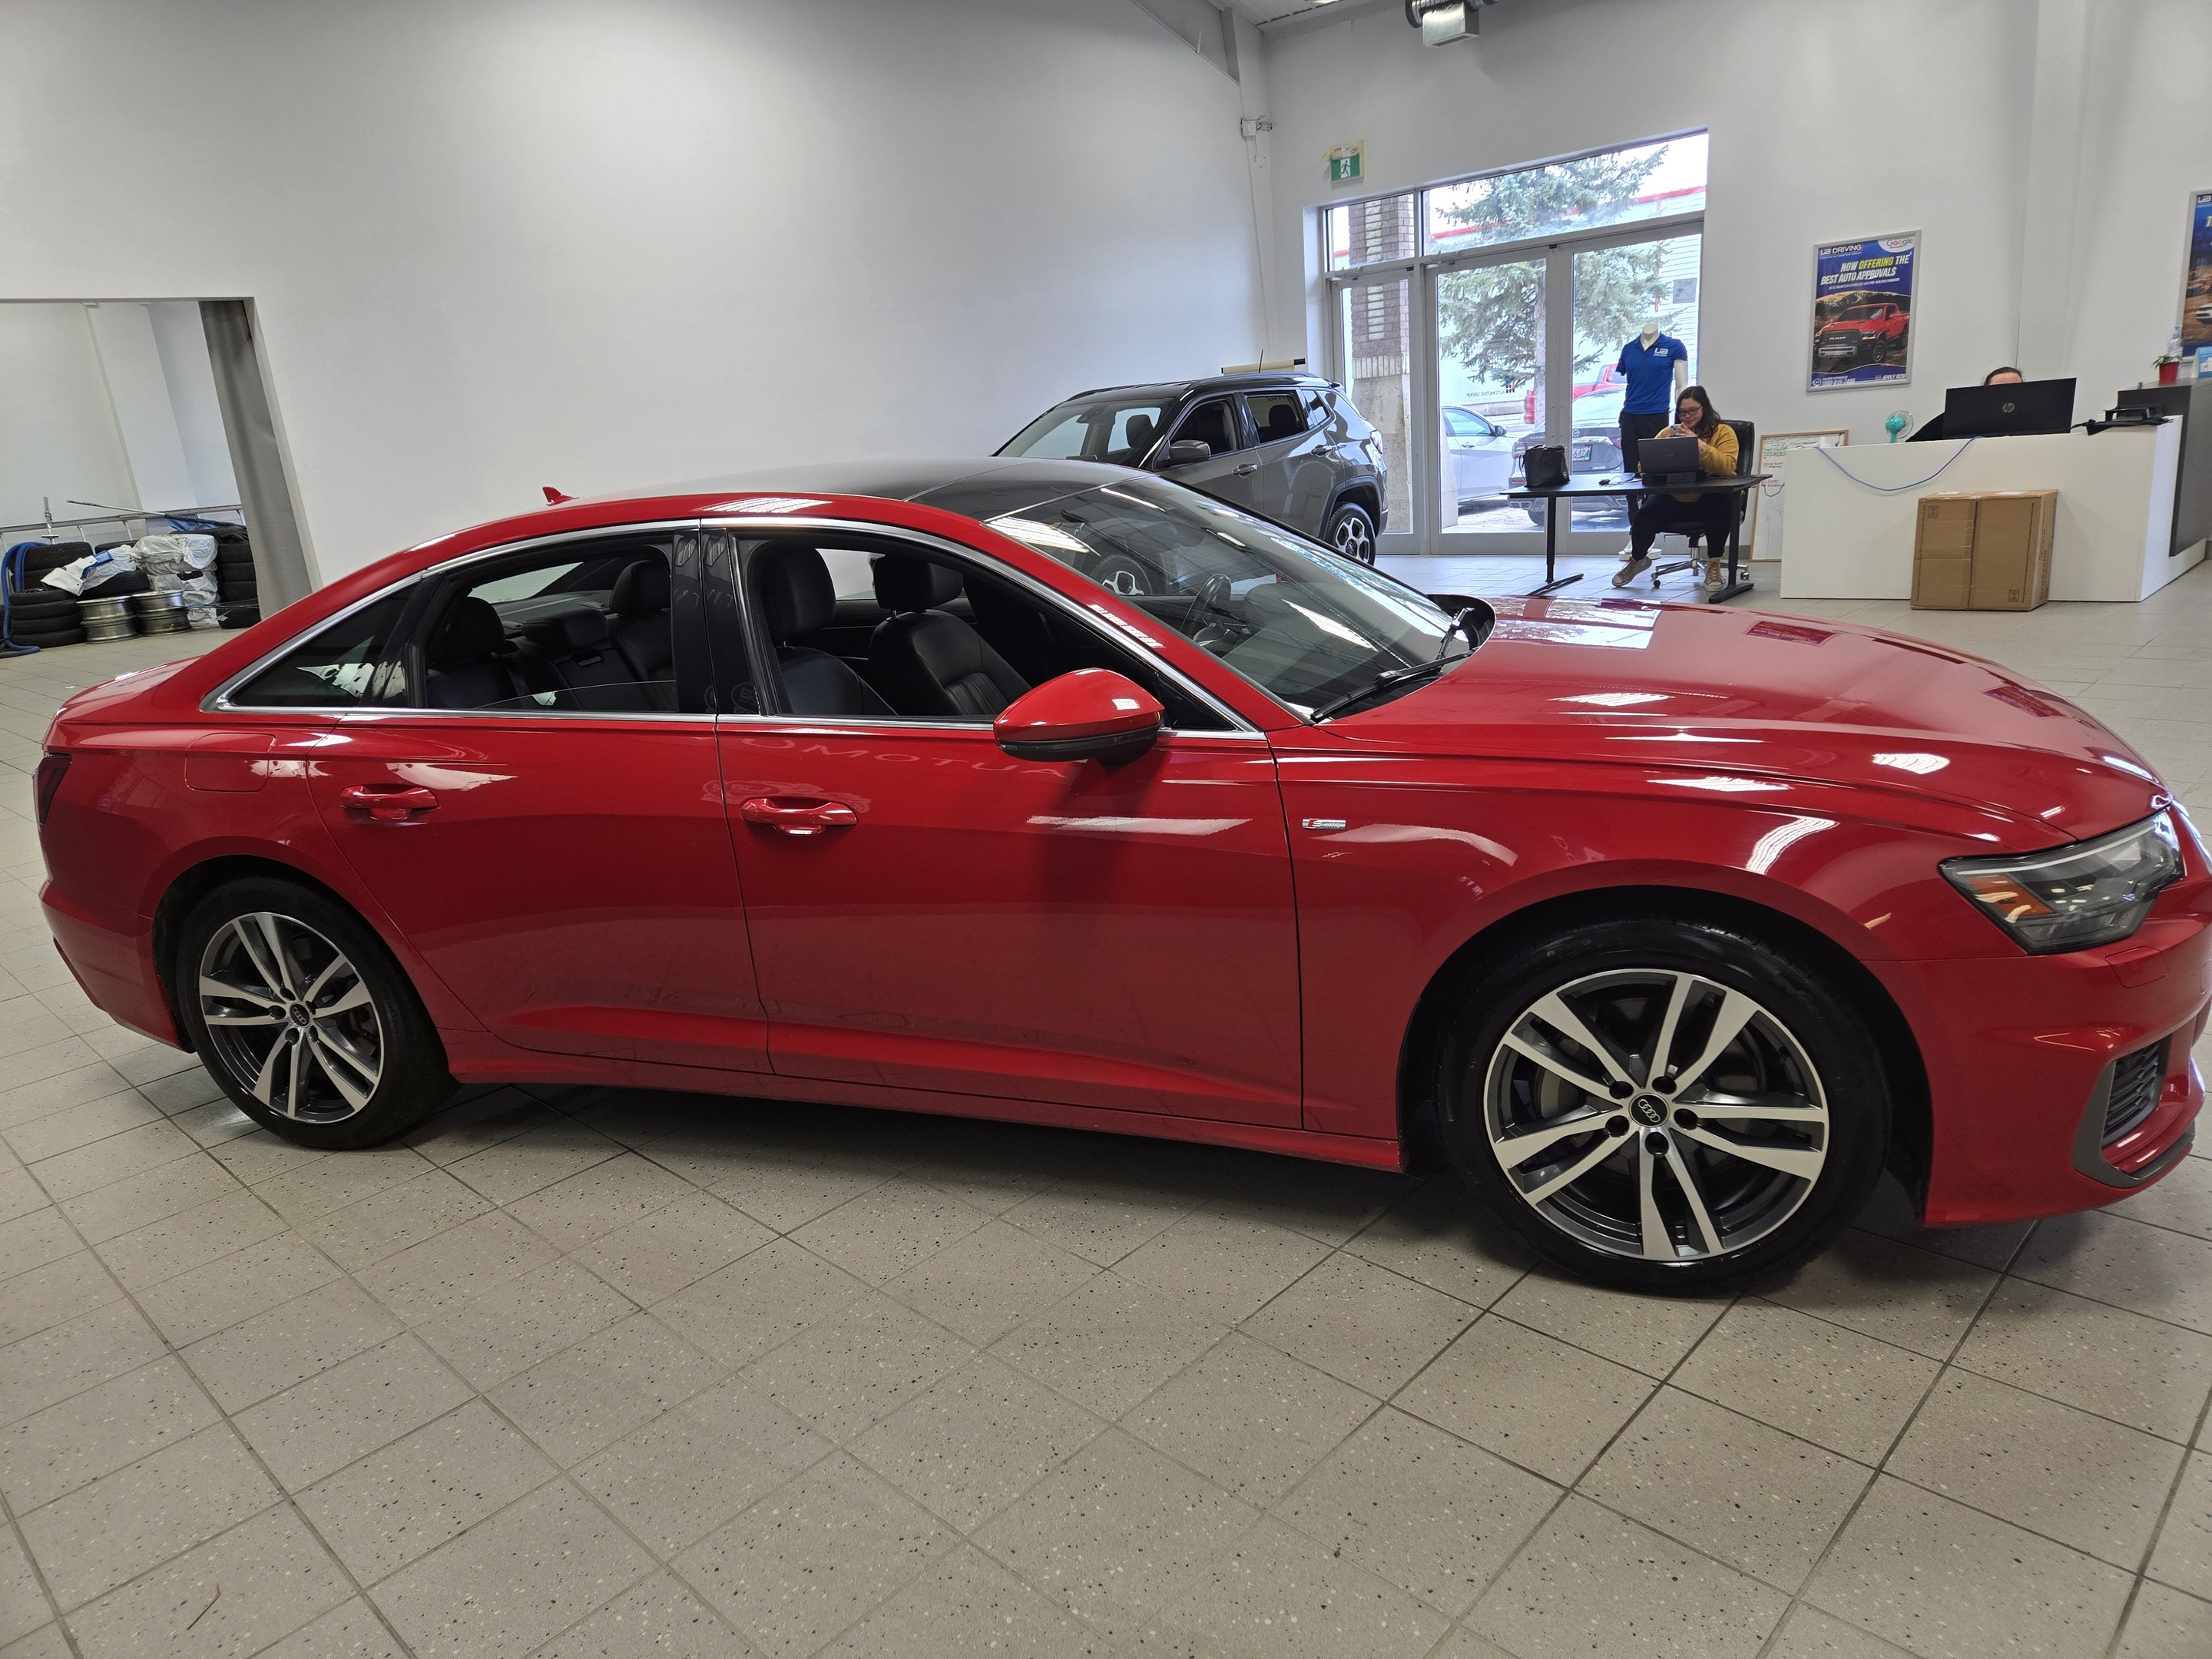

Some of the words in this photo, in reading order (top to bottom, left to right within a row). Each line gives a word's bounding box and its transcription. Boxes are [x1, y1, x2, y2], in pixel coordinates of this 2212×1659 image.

[1886, 237, 1913, 247] Google
[1832, 244, 1862, 254] DRIVING
[1841, 261, 1858, 272] NOW
[1859, 256, 1893, 269] OFFERING
[1896, 255, 1909, 265] THE
[1820, 274, 1839, 286] BEST
[1839, 272, 1856, 283] AUTO
[1857, 267, 1896, 280] APPROVALS
